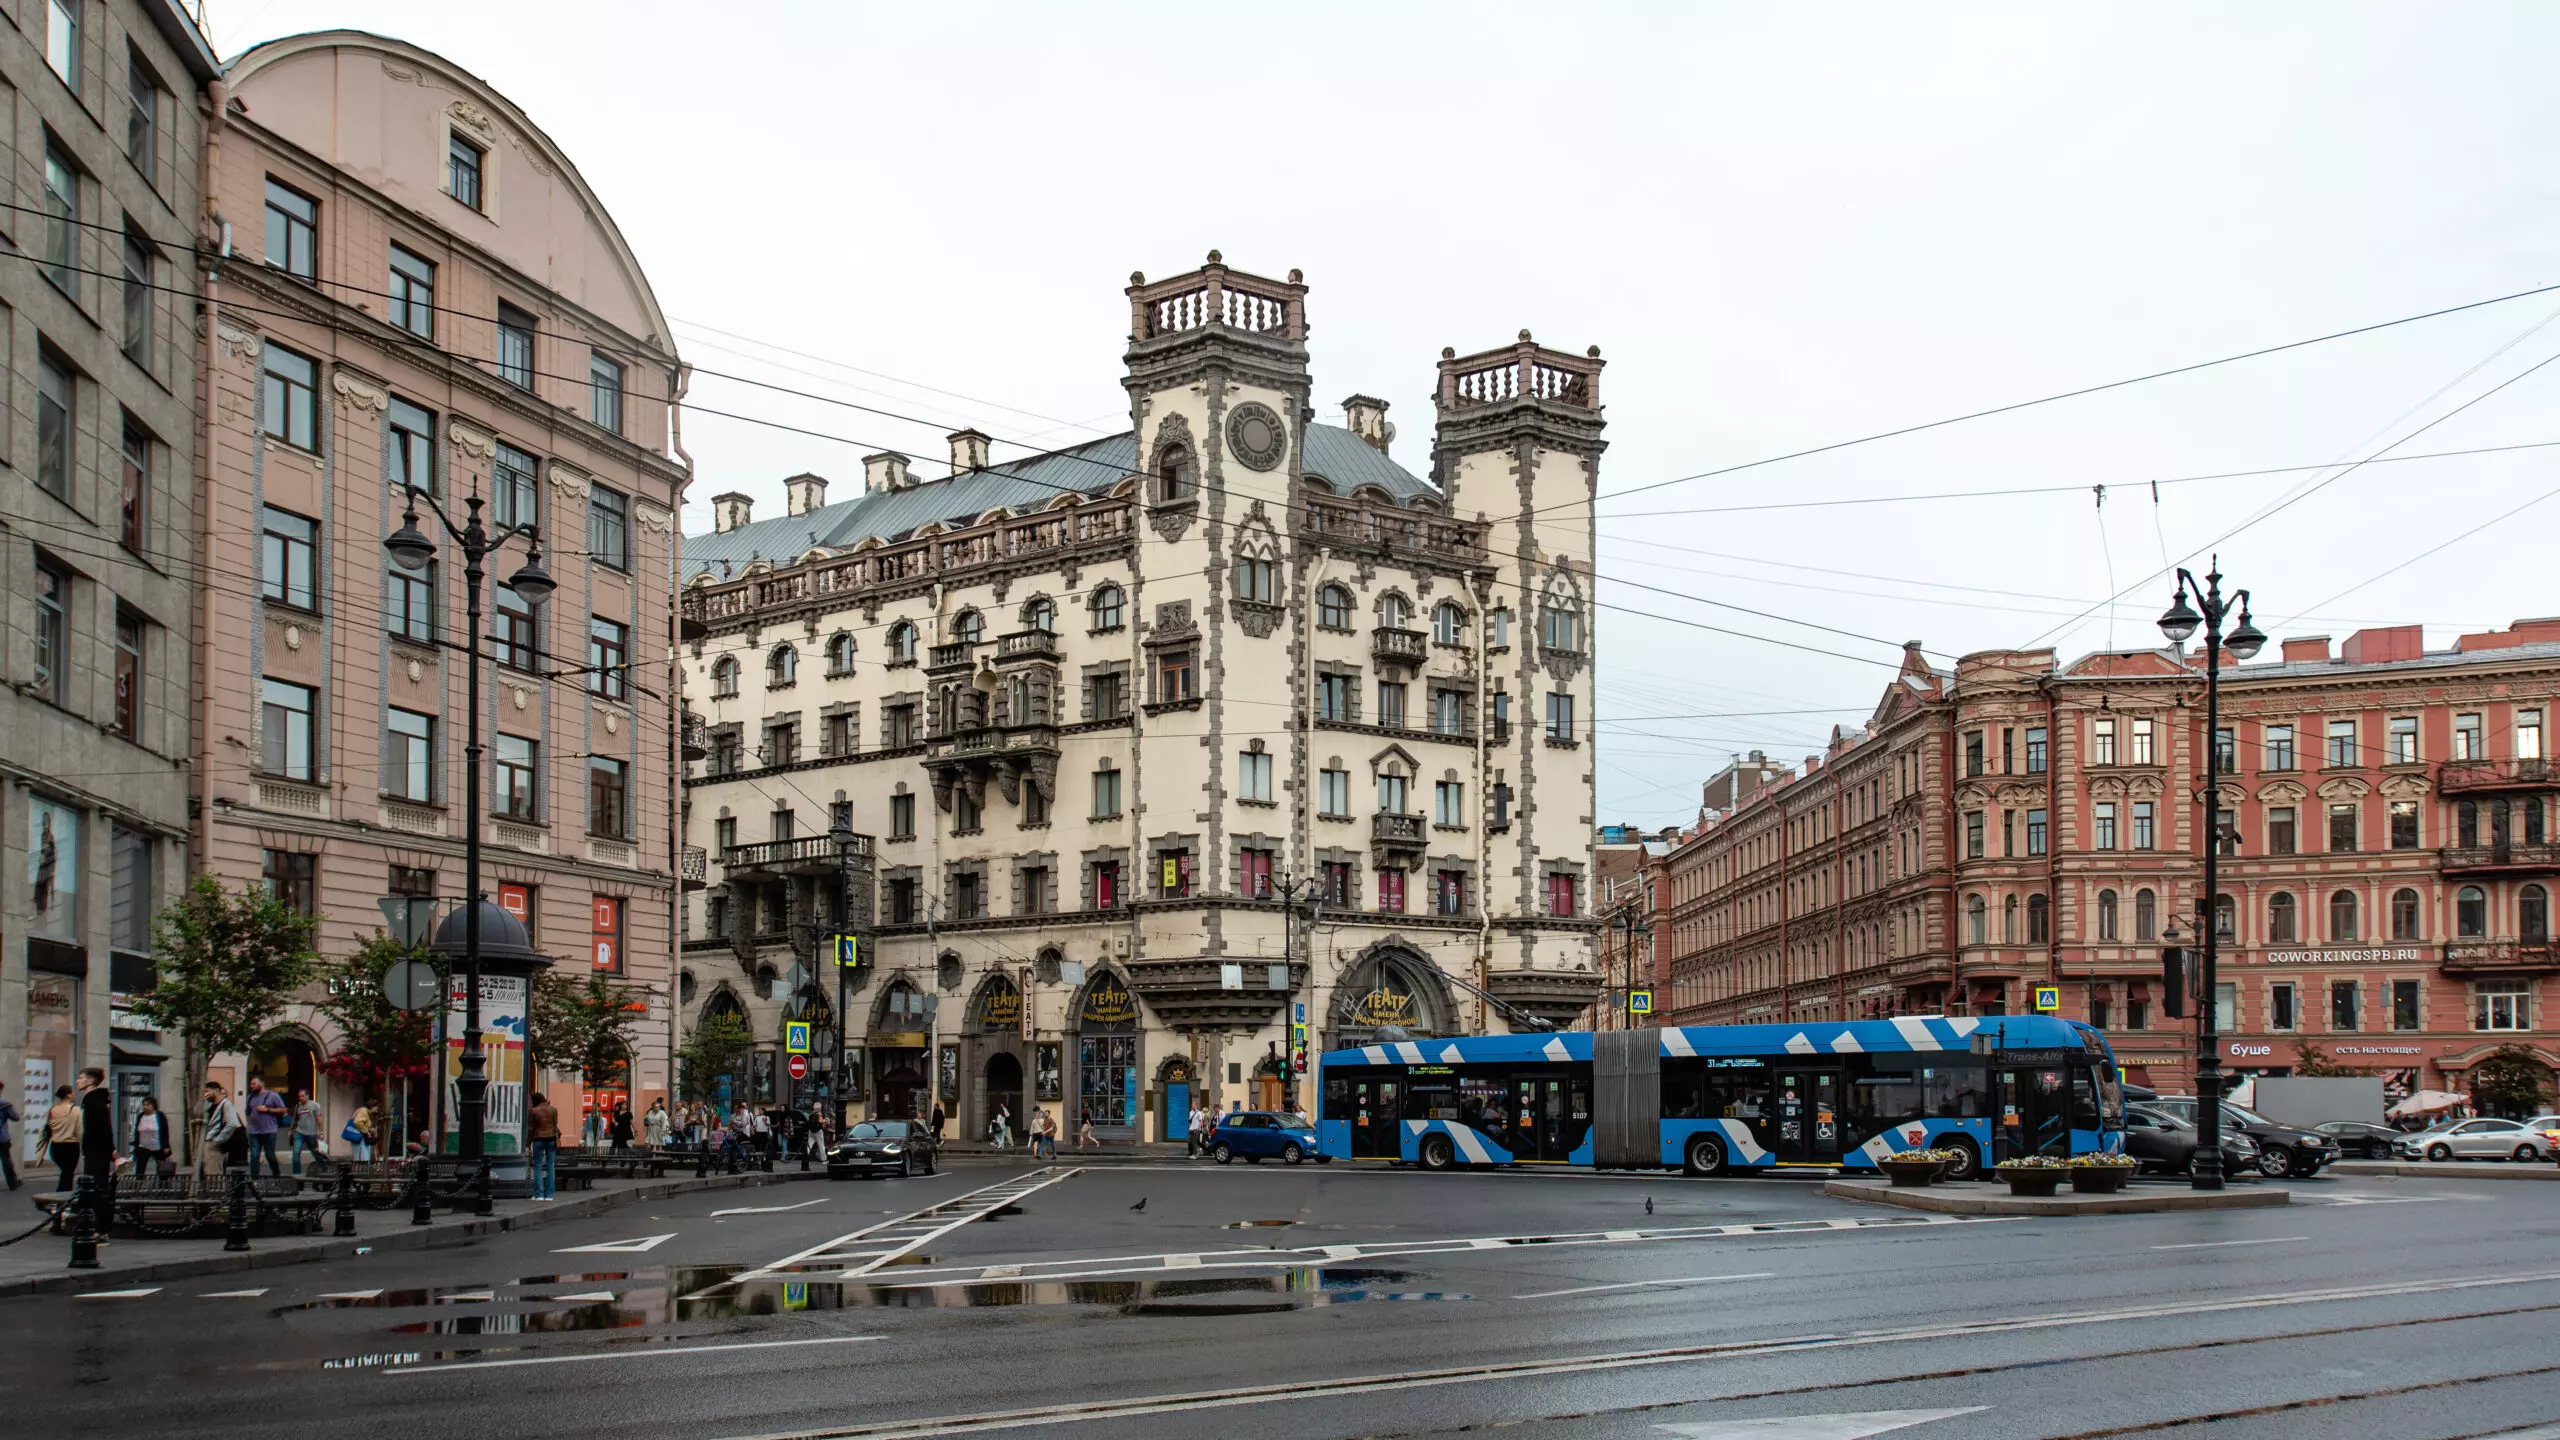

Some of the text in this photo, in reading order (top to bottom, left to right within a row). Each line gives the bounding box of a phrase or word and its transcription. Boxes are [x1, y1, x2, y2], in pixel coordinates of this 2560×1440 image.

[2268, 950, 2417, 963] COWORKINGSPB.RU
[28, 990, 70, 1009] КАМЕНЬ
[988, 990, 1020, 1009] ТЕАТР
[1091, 986, 1128, 1005] ТЕАТР
[1367, 987, 1407, 1010] ТЕАТР
[1353, 1014, 1381, 1026] АНДРЕЯ
[2230, 1043, 2271, 1057] буше
[2336, 1046, 2421, 1055] есть настоящее
[1707, 1059, 1716, 1068] 31
[1408, 1066, 1415, 1075] 31
[1572, 1112, 1588, 1120] 5107
[1724, 1106, 1737, 1117] 31
